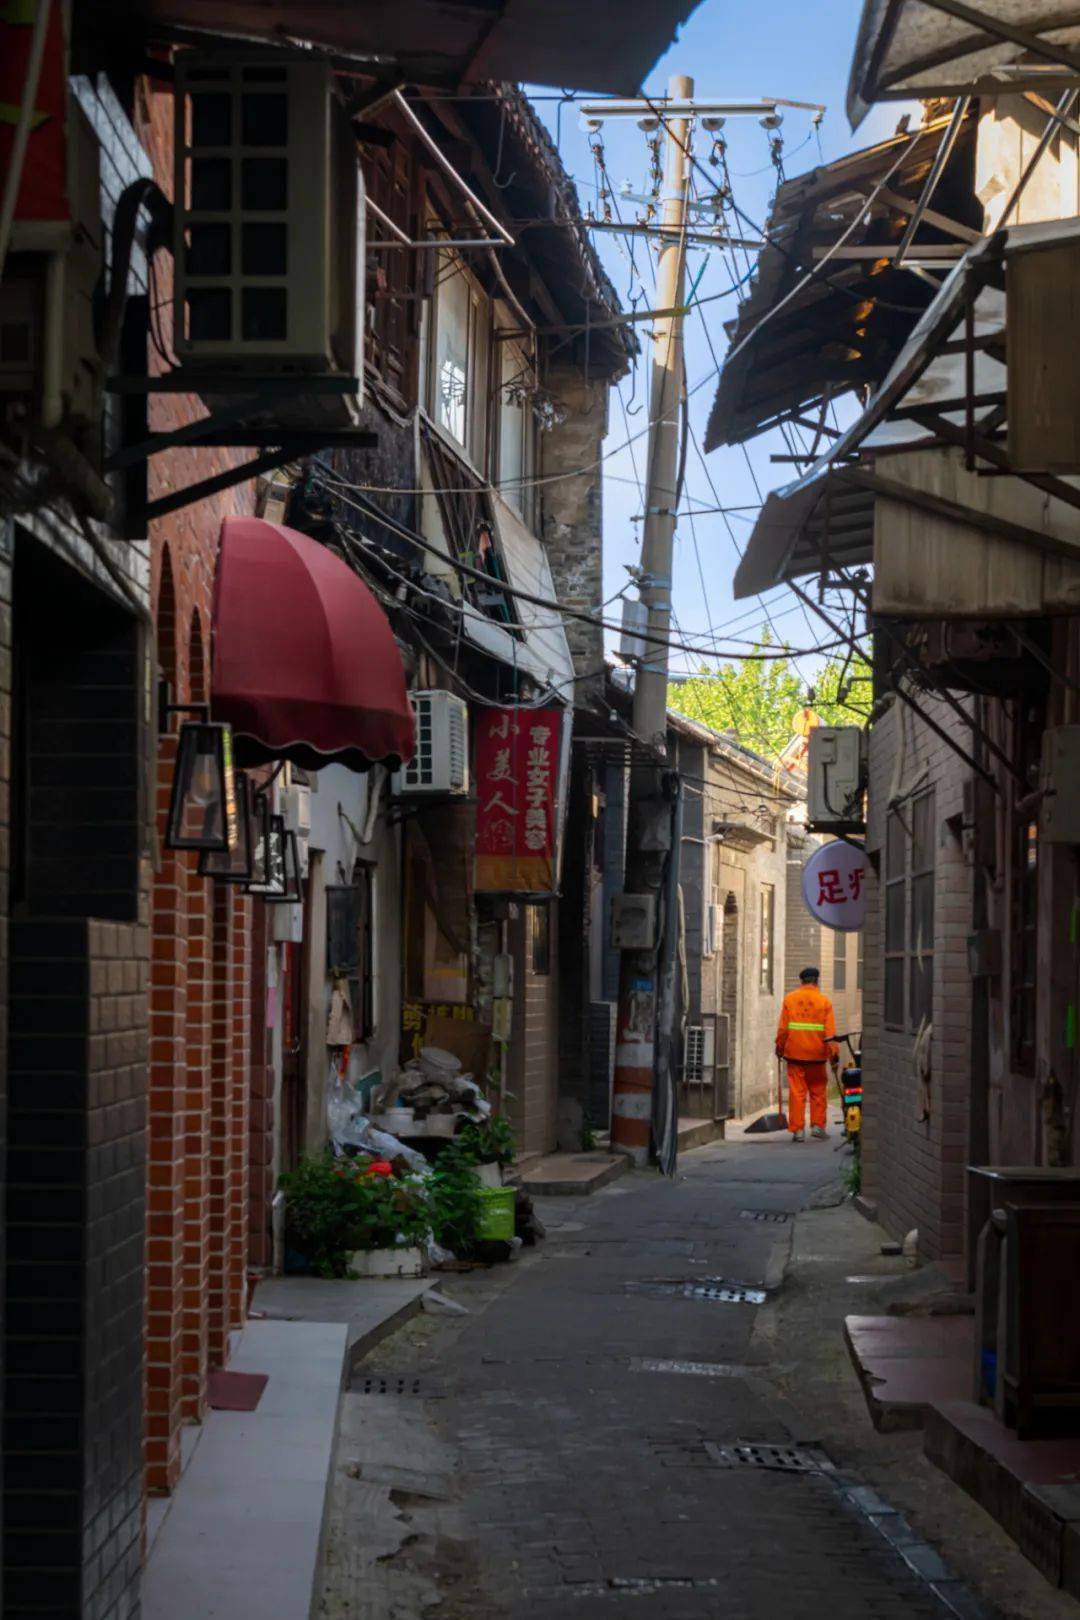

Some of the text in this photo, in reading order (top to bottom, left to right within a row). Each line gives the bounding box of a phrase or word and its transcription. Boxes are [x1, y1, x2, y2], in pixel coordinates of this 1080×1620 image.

[525, 726, 551, 849] 专业女子美容
